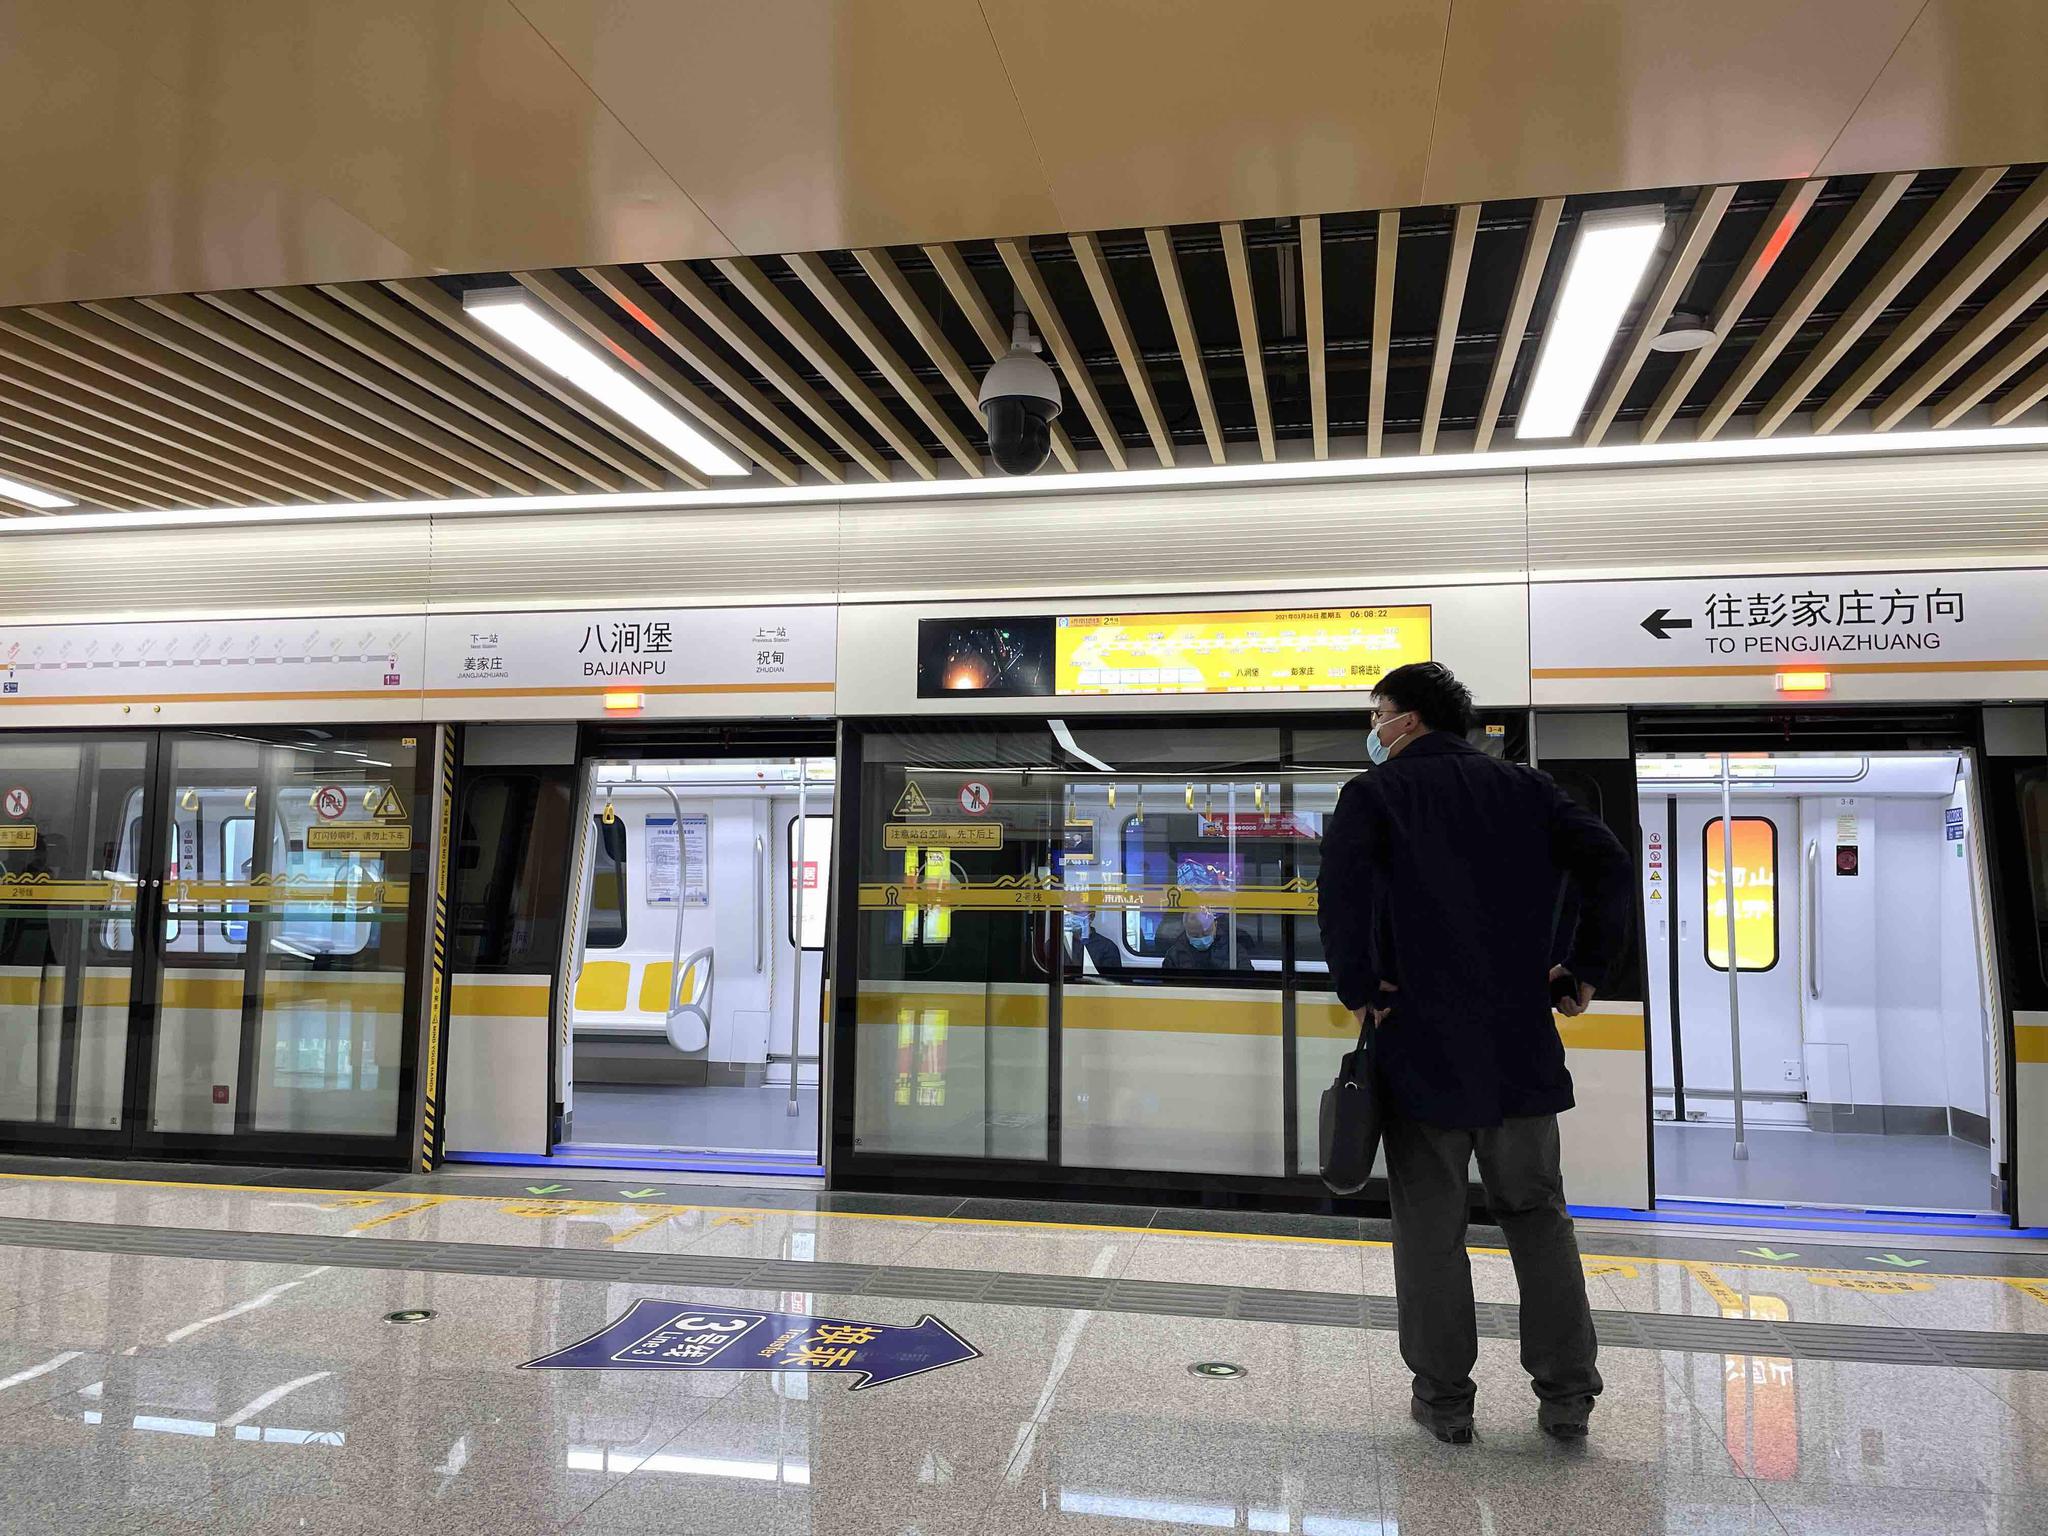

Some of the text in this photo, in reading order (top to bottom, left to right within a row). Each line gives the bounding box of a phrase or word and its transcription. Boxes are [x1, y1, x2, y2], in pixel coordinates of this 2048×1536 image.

[1350, 609, 1388, 618] 06:08:22
[1704, 588, 1965, 630] 往彭家庄方向
[470, 633, 498, 643] 下一站
[578, 622, 673, 654] 八涧堡
[755, 626, 786, 637] 上一站
[1705, 632, 1941, 653] TO PENGJIAZHUANG
[463, 656, 503, 671] 姜家庄
[756, 650, 785, 665] 祝甸
[583, 660, 666, 676] BAJIANPU
[1290, 666, 1315, 676] 彭家庄
[1350, 664, 1381, 676] 即将进站
[641, 1331, 684, 1348] Line
[757, 1328, 808, 1358] Transfer
[779, 1324, 883, 1368] 换乘
